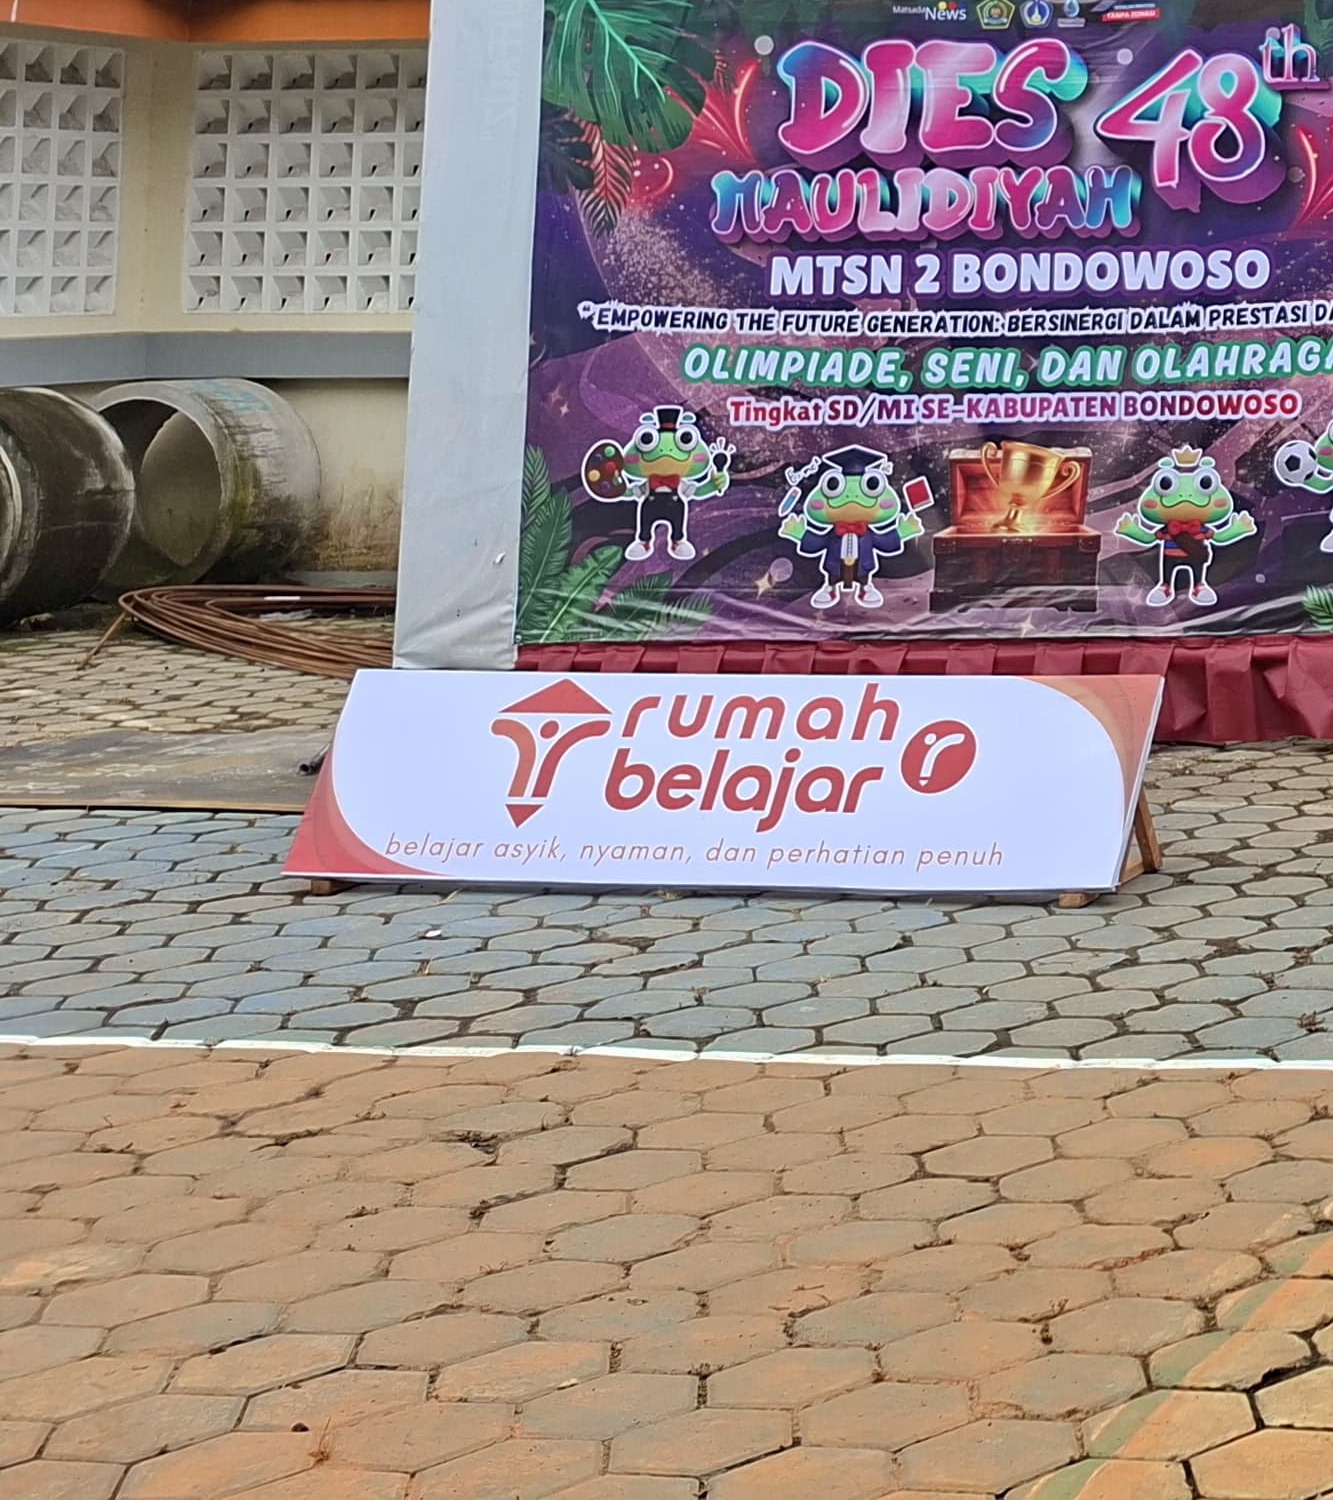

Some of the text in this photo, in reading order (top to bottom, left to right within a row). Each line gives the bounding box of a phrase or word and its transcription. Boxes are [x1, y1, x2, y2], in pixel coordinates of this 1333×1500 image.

[925, 6, 967, 21] News
[777, 38, 1070, 155] DIES
[710, 165, 1135, 235] MAULIDIYAH
[770, 249, 1271, 296] MTSN 2 BONDOWOSO
[736, 312, 776, 331] THE
[782, 313, 859, 333] FUTURE
[866, 313, 1001, 334] GENERATION:
[1007, 311, 1123, 332] BERSINERGI
[1130, 308, 1201, 330] DALAM
[1208, 304, 1308, 327] PRESTASI
[684, 347, 910, 388] OLIMPIADE,
[925, 351, 1026, 389] SENI,
[1041, 348, 1123, 383] DAN
[730, 400, 821, 426] Tingkat
[827, 395, 915, 424] SD/MI
[1124, 392, 1299, 419] BONDOWOSO
[622, 682, 900, 744] rumah
[605, 747, 884, 832] belajar
[384, 832, 1003, 873] belajar asyik, nyaman, dan perhatian penuh
